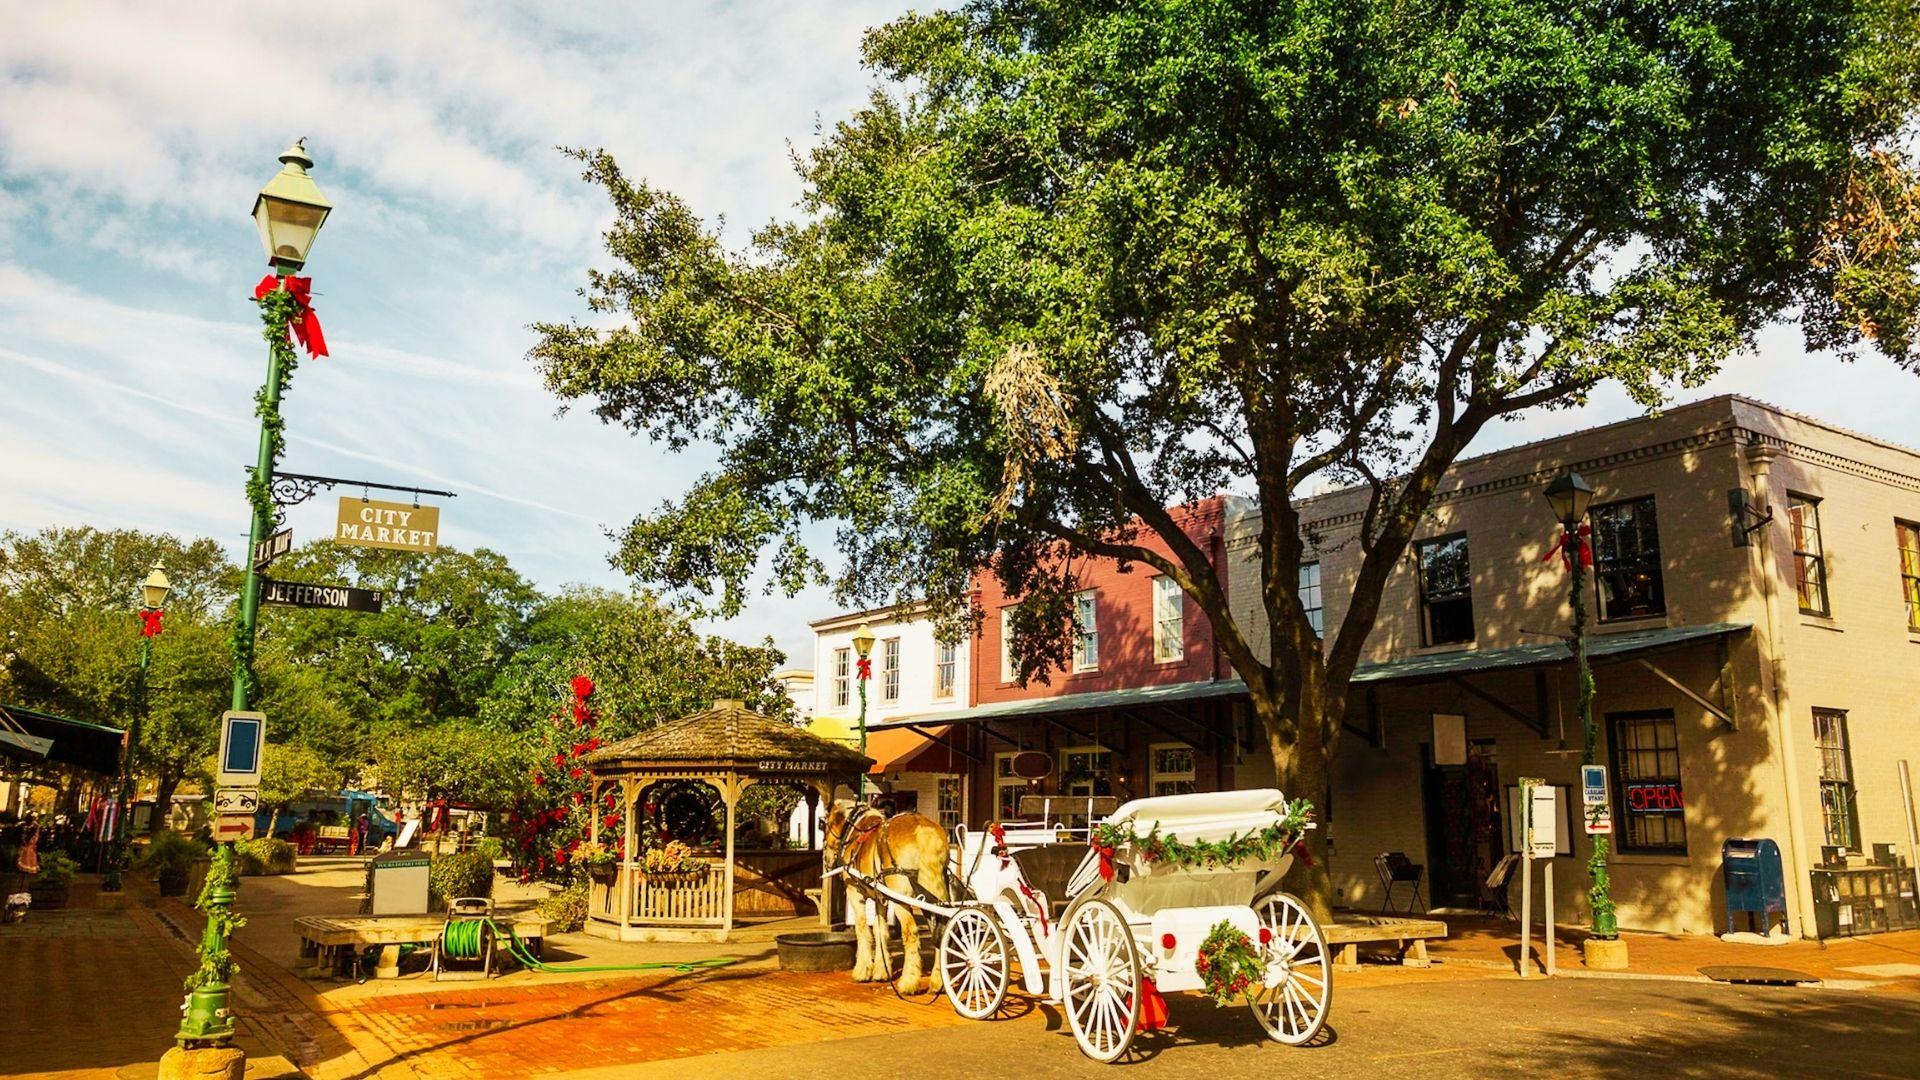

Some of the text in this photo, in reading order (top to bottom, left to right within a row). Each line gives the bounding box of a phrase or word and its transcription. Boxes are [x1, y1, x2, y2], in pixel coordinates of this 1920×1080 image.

[360, 507, 412, 527] CITY
[341, 523, 434, 546] MARKET
[267, 583, 381, 607] JEFFERSON ST
[759, 761, 828, 771] CITY MARKET
[1631, 786, 1684, 809] OPEN
